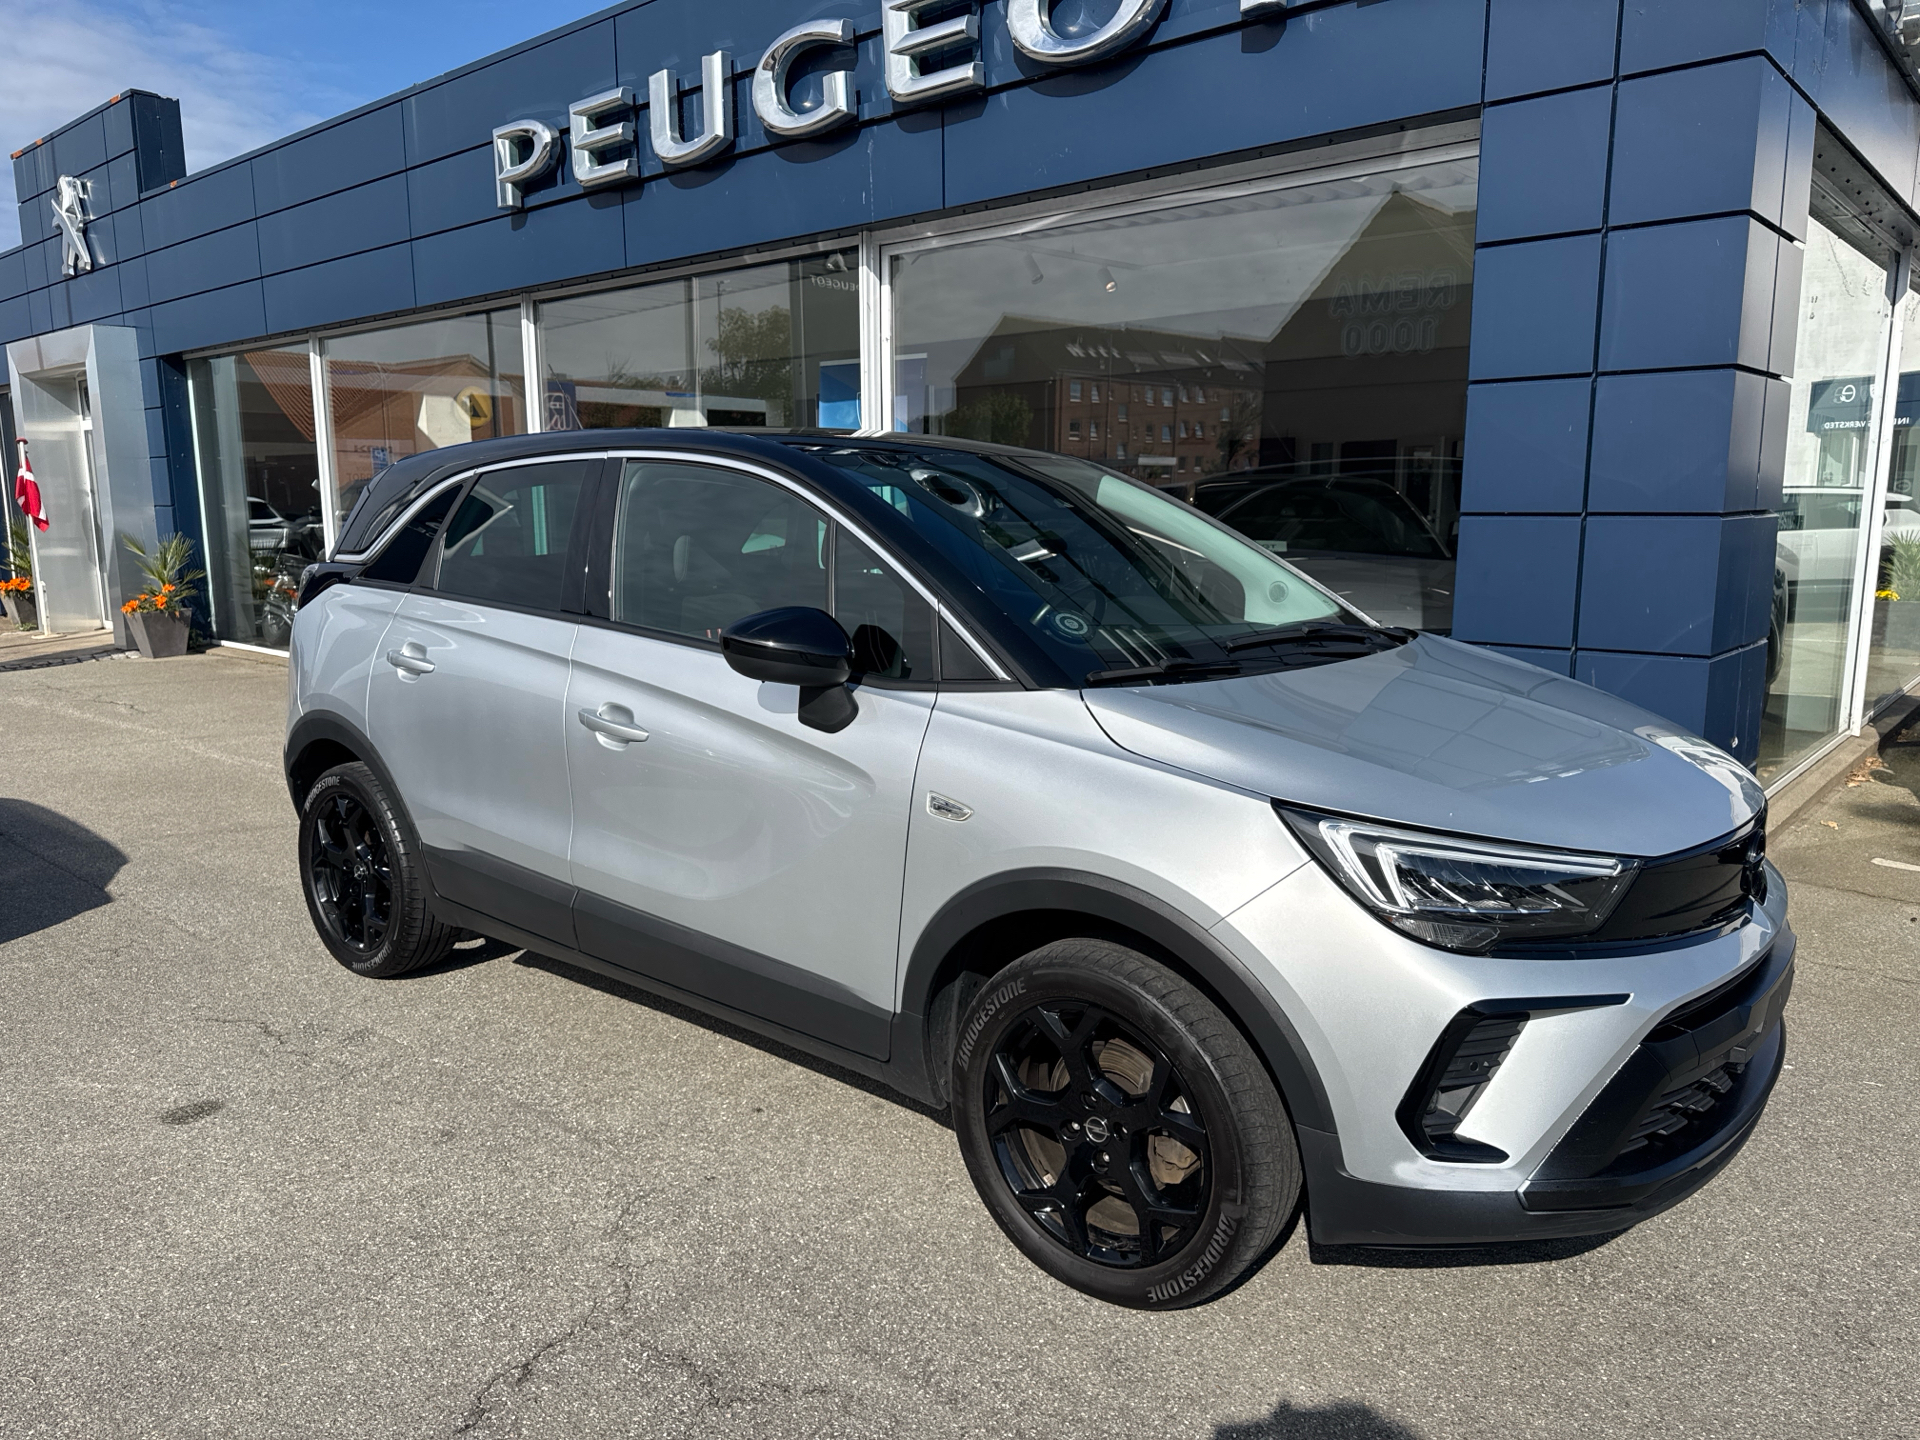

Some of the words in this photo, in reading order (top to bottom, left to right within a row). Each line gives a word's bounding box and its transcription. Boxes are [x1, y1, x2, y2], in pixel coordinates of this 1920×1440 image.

[491, 0, 1288, 211] PEUGEO
[956, 977, 1027, 1072] BRIDGESTONE
[1146, 1211, 1238, 1303] BRIDGESTONE
